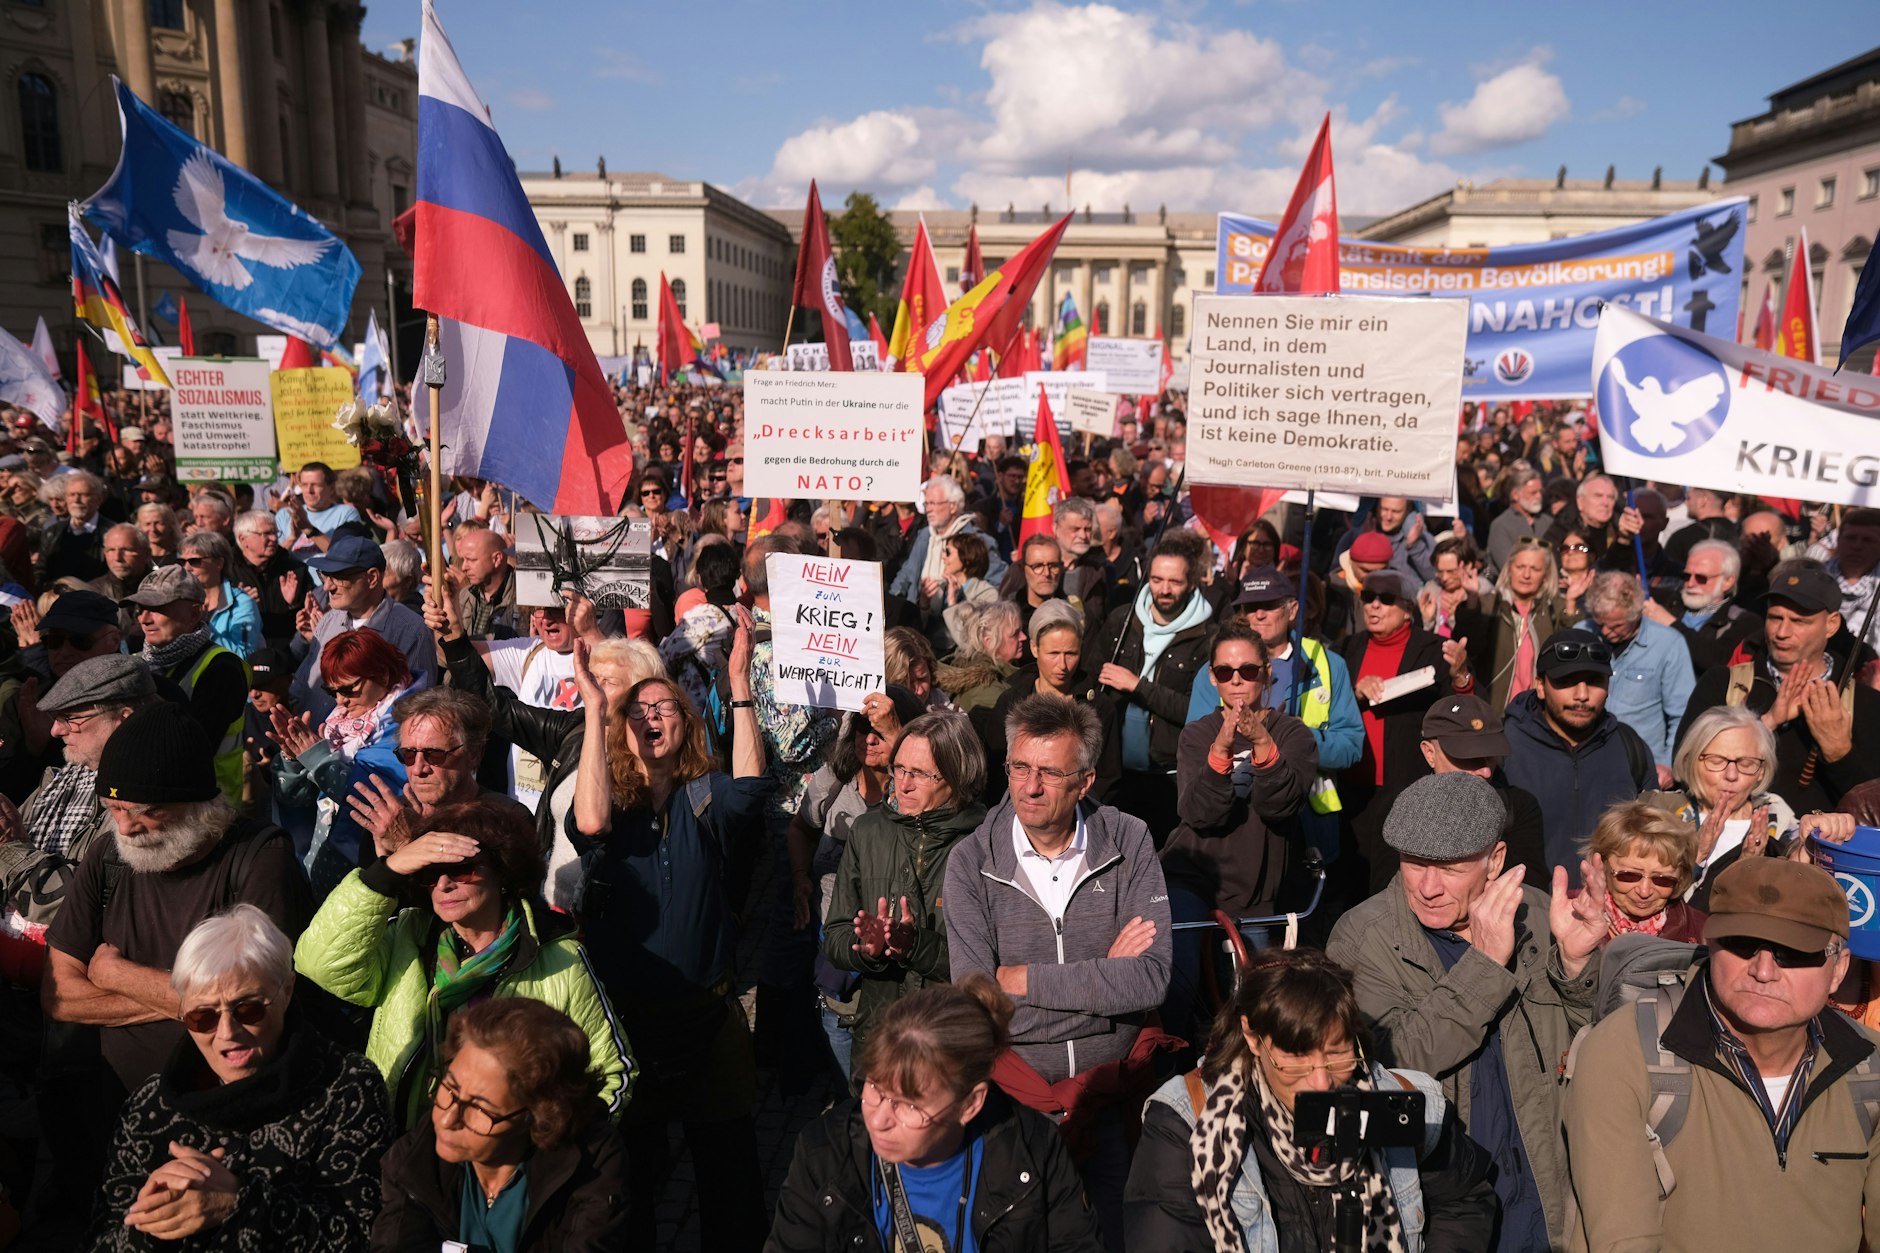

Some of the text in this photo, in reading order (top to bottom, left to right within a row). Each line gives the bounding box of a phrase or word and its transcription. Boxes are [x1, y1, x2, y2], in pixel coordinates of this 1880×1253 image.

[1380, 250, 1424, 264] mit
[1432, 250, 1481, 264] der
[1233, 254, 1666, 289] Paensischen Bevölkerung!
[1208, 313, 1388, 332] Nennen Sie mir ein
[1206, 336, 1327, 354] Land, in dem
[176, 370, 224, 386] ECHTER
[1204, 360, 1364, 378] Journalisten und
[754, 378, 773, 387] Frage
[785, 379, 816, 387] Friedrich
[178, 389, 266, 407] SOZIALISMUS,
[760, 398, 788, 406] macht
[790, 398, 813, 406] Putin
[825, 399, 840, 407] der
[842, 400, 877, 409] Ukraine
[896, 402, 909, 410] die
[1204, 382, 1432, 408] Politiker sich vertragen,
[1202, 406, 1418, 430] und ich sage Ihnen, da
[753, 424, 915, 442] „Drecksarbeit“
[1201, 426, 1398, 452] ist keine Demokratie.
[183, 442, 250, 450] katastrophe!
[764, 456, 899, 467] gegen die Bedrohung durch die
[1209, 457, 1431, 480] Hugh Carleton Greene (1910-87), brit. Publizist
[1735, 440, 1880, 488] KRIEG
[223, 466, 273, 480] MLPD
[798, 475, 874, 491] NATO?
[802, 562, 851, 582] NEIN
[807, 632, 858, 654] NEIN
[819, 657, 841, 667] ZUR
